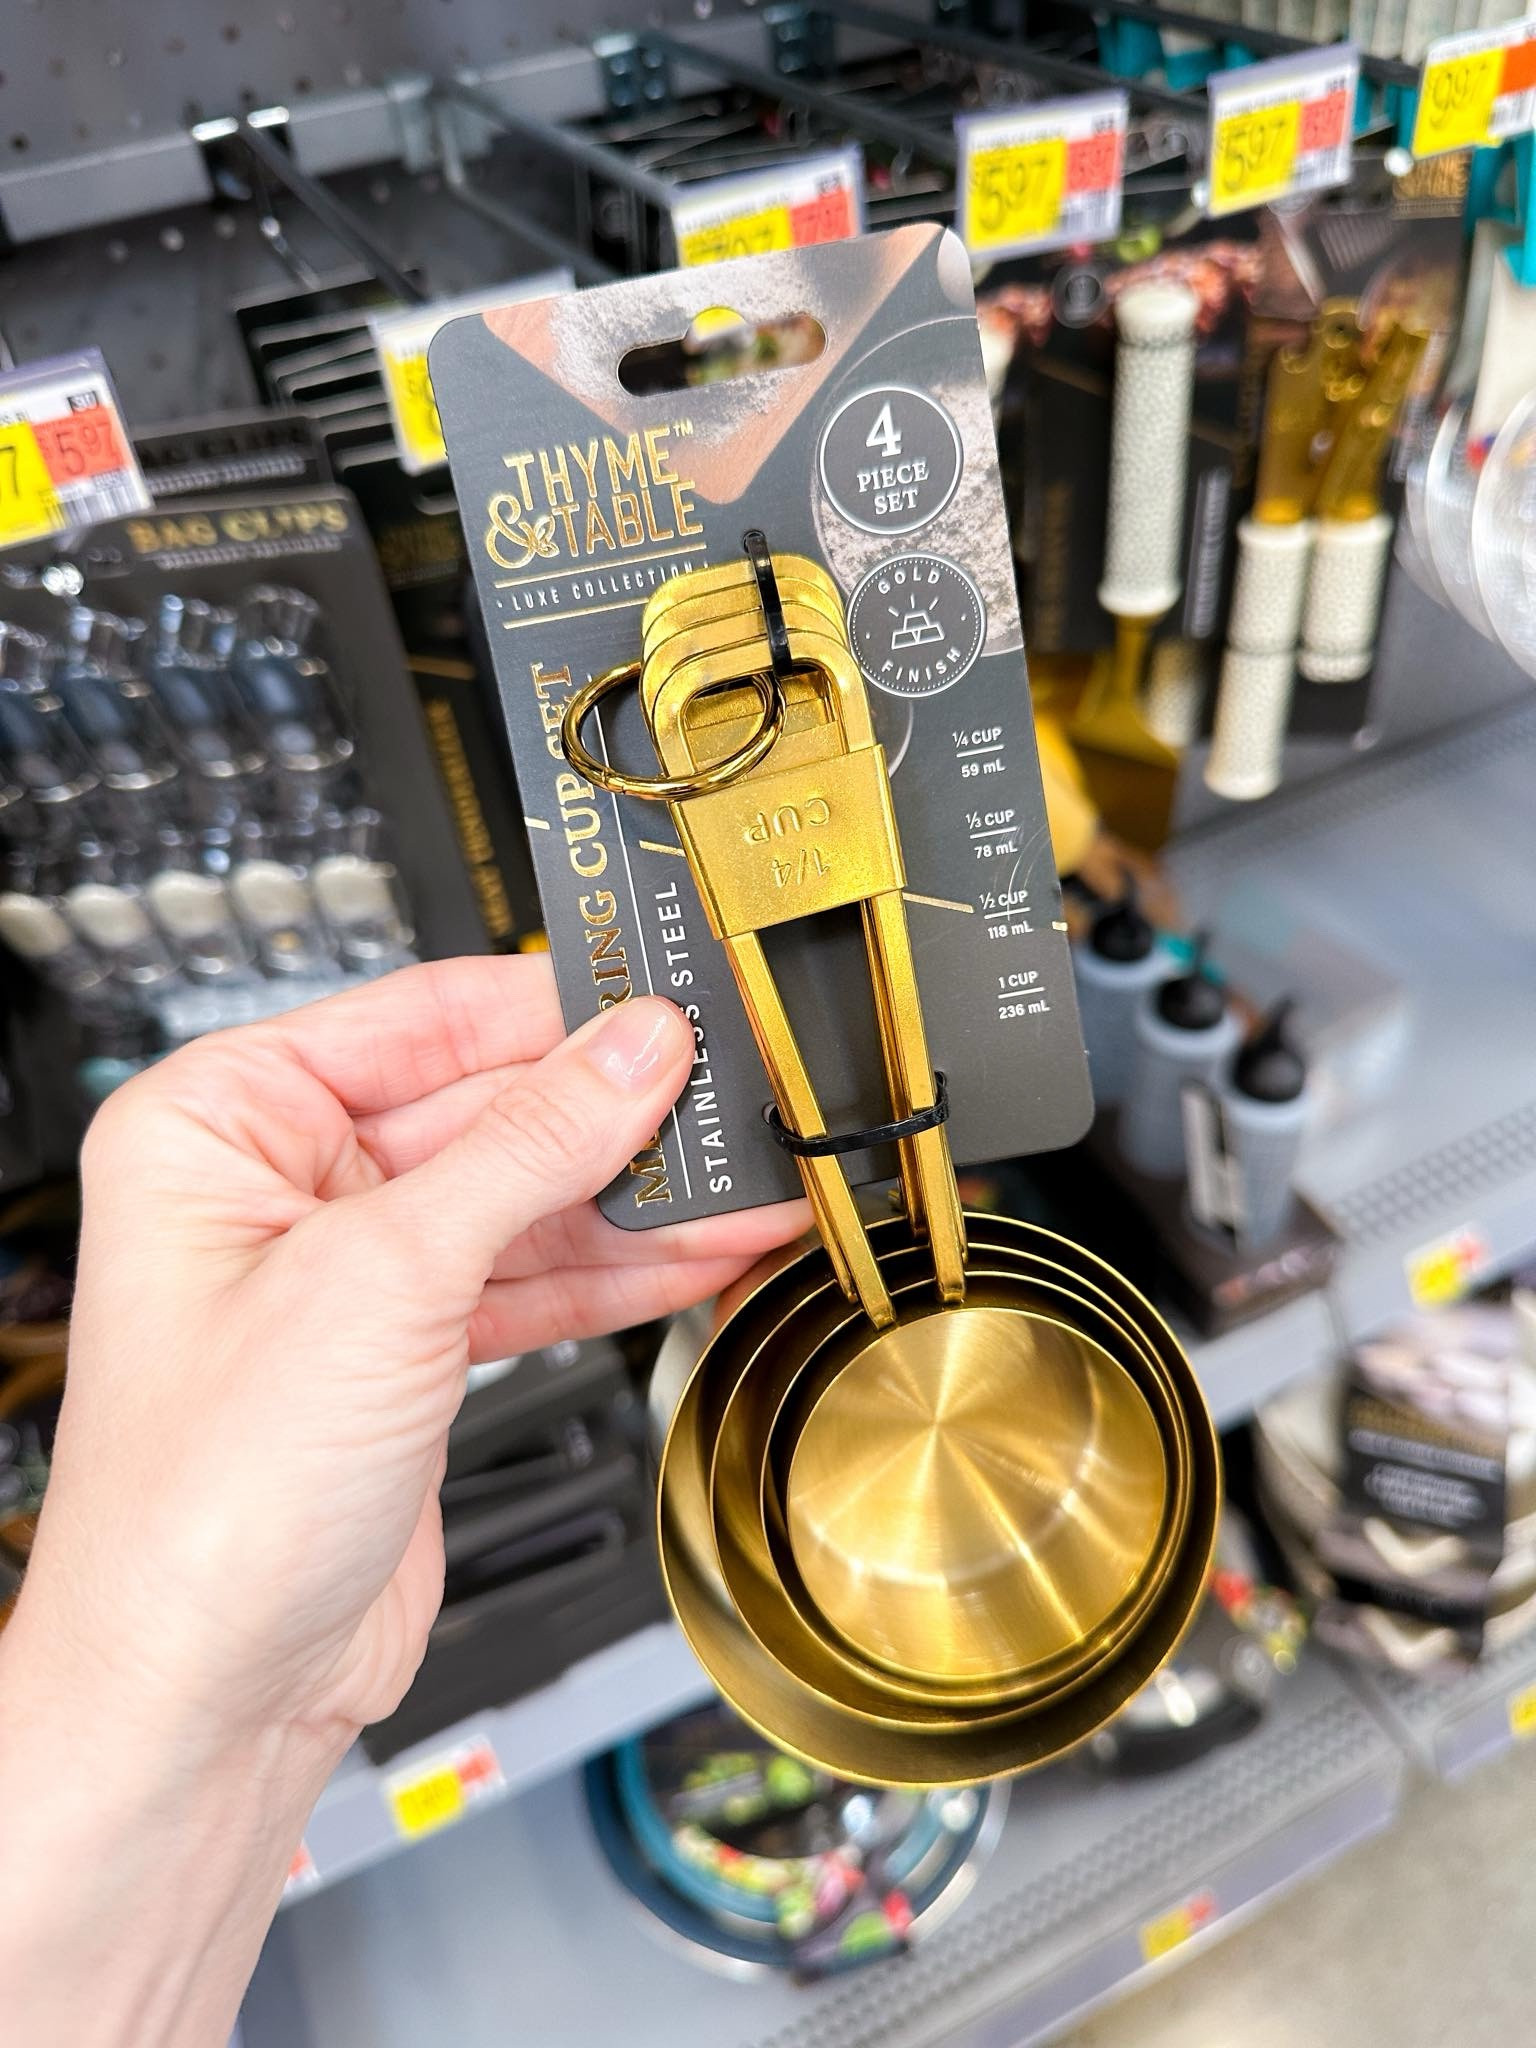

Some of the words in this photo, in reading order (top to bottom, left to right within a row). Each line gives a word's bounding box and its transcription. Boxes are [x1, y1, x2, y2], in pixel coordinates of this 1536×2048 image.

[865, 400, 902, 458] 4
[857, 461, 929, 493] PIECE
[874, 488, 918, 516] SET
[511, 588, 560, 612] LUXE
[572, 560, 693, 600] COLLECTION
[877, 565, 940, 596] GOLD
[881, 647, 961, 684] FINISH
[972, 726, 1003, 745] CUP
[961, 764, 981, 779] 59
[983, 759, 1006, 776] mL
[555, 772, 608, 878] CUP
[743, 797, 833, 847] CUP
[984, 808, 1016, 827] CUP
[974, 844, 993, 860] 78
[995, 840, 1019, 856] mL
[771, 848, 832, 889] 1/4
[998, 889, 1030, 907] CUP
[655, 881, 694, 987] STEEL
[987, 924, 1009, 940] 118
[1011, 920, 1034, 937] mL
[998, 975, 1006, 990] 1
[1008, 970, 1039, 988] CUP
[998, 1003, 1025, 1020] 236
[1027, 998, 1051, 1016] mL
